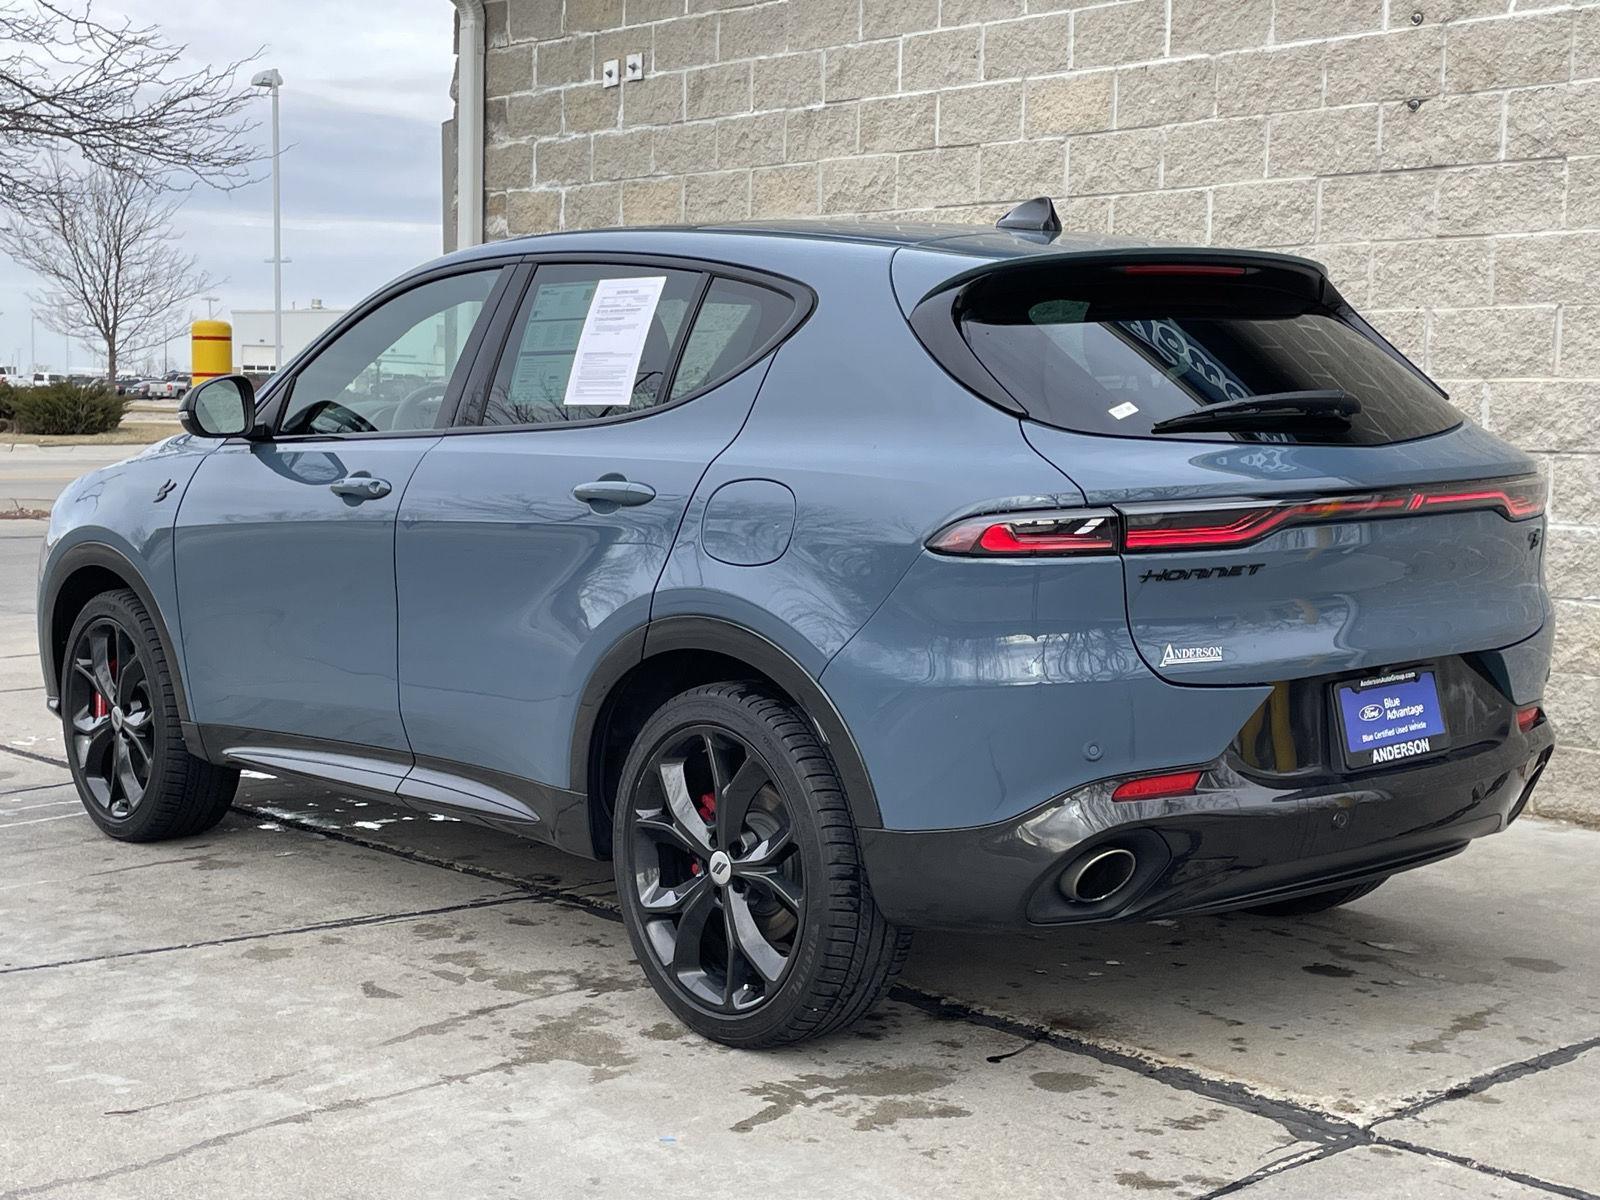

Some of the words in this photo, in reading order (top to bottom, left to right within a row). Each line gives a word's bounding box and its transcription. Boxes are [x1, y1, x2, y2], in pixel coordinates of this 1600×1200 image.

[1138, 563, 1266, 584] HORNET
[1159, 643, 1223, 668] ANDERSON
[1383, 697, 1401, 709] Blue
[1386, 704, 1424, 720] Advantage
[1362, 735, 1373, 743] Blue
[1374, 729, 1395, 739] Certified
[1396, 726, 1408, 735] Used
[1409, 722, 1427, 730] Vehicle
[1373, 739, 1430, 763] ANDERSON
